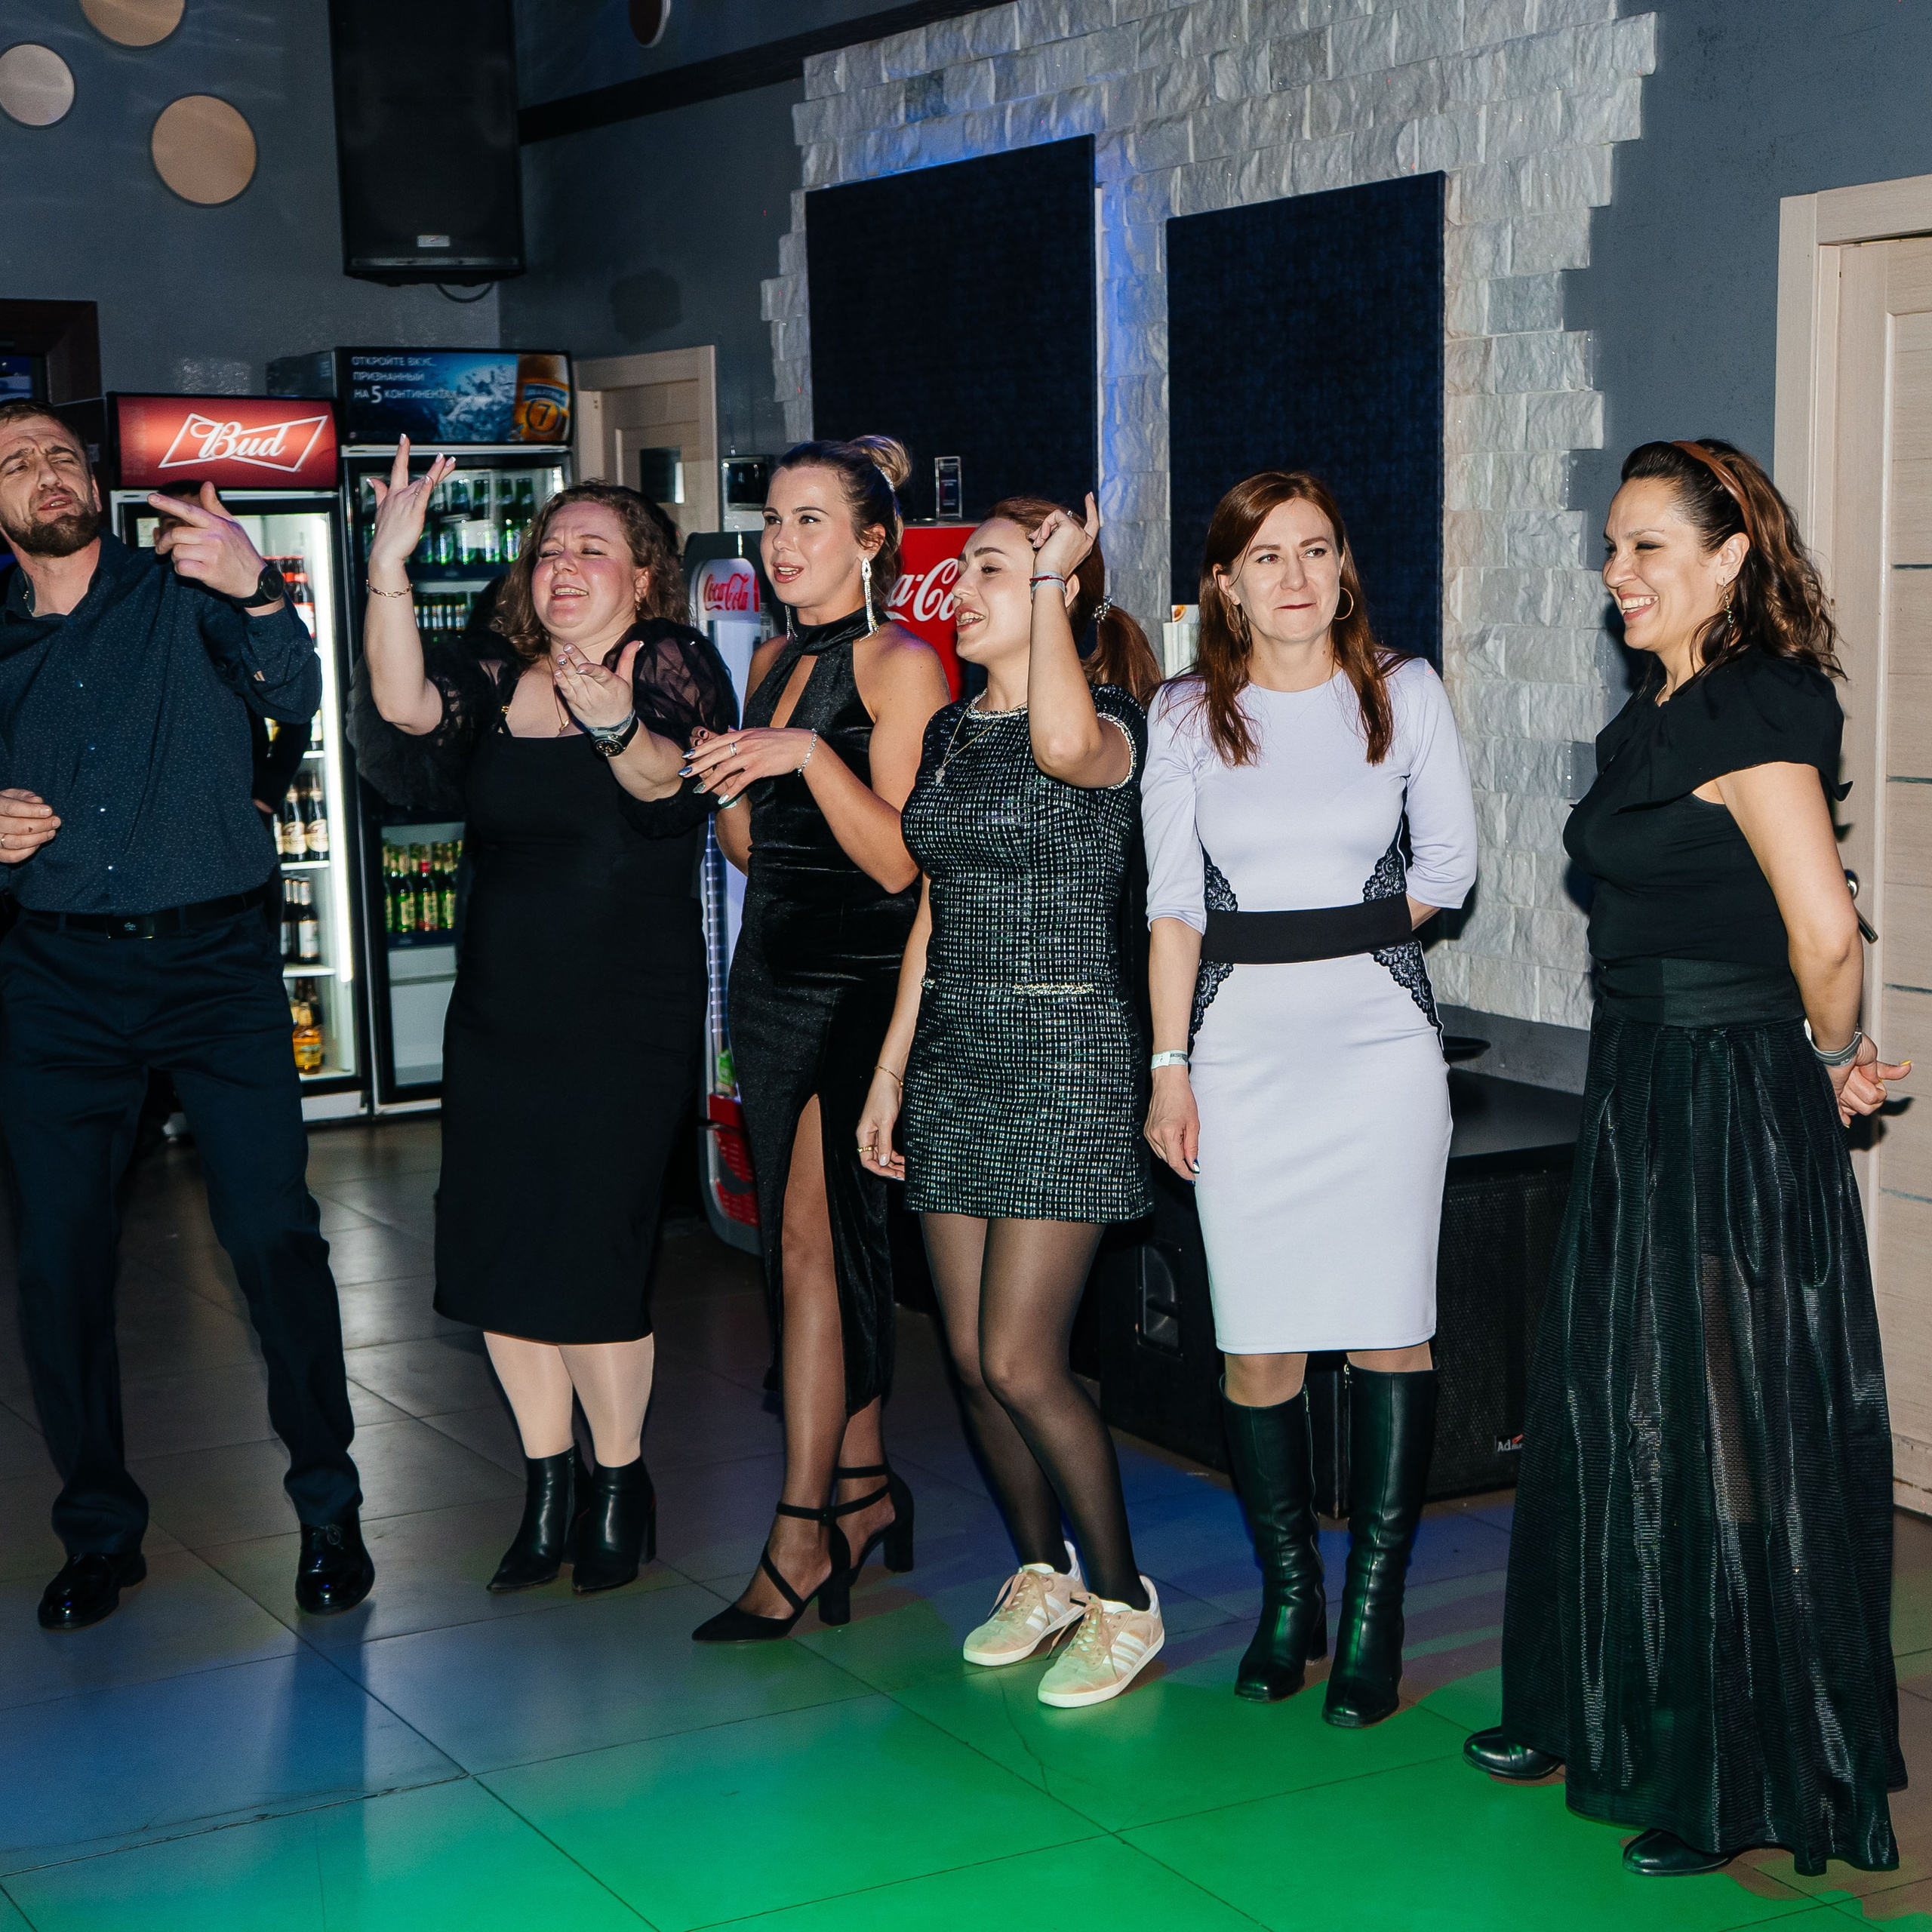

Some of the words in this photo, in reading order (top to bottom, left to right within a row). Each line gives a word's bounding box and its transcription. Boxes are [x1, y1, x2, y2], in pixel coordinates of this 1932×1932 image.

[351, 355, 406, 366] ОТКРОЙТЕ
[354, 389, 370, 398] НА
[371, 385, 383, 404] 5
[537, 403, 551, 427] 7
[190, 421, 286, 460] Bud
